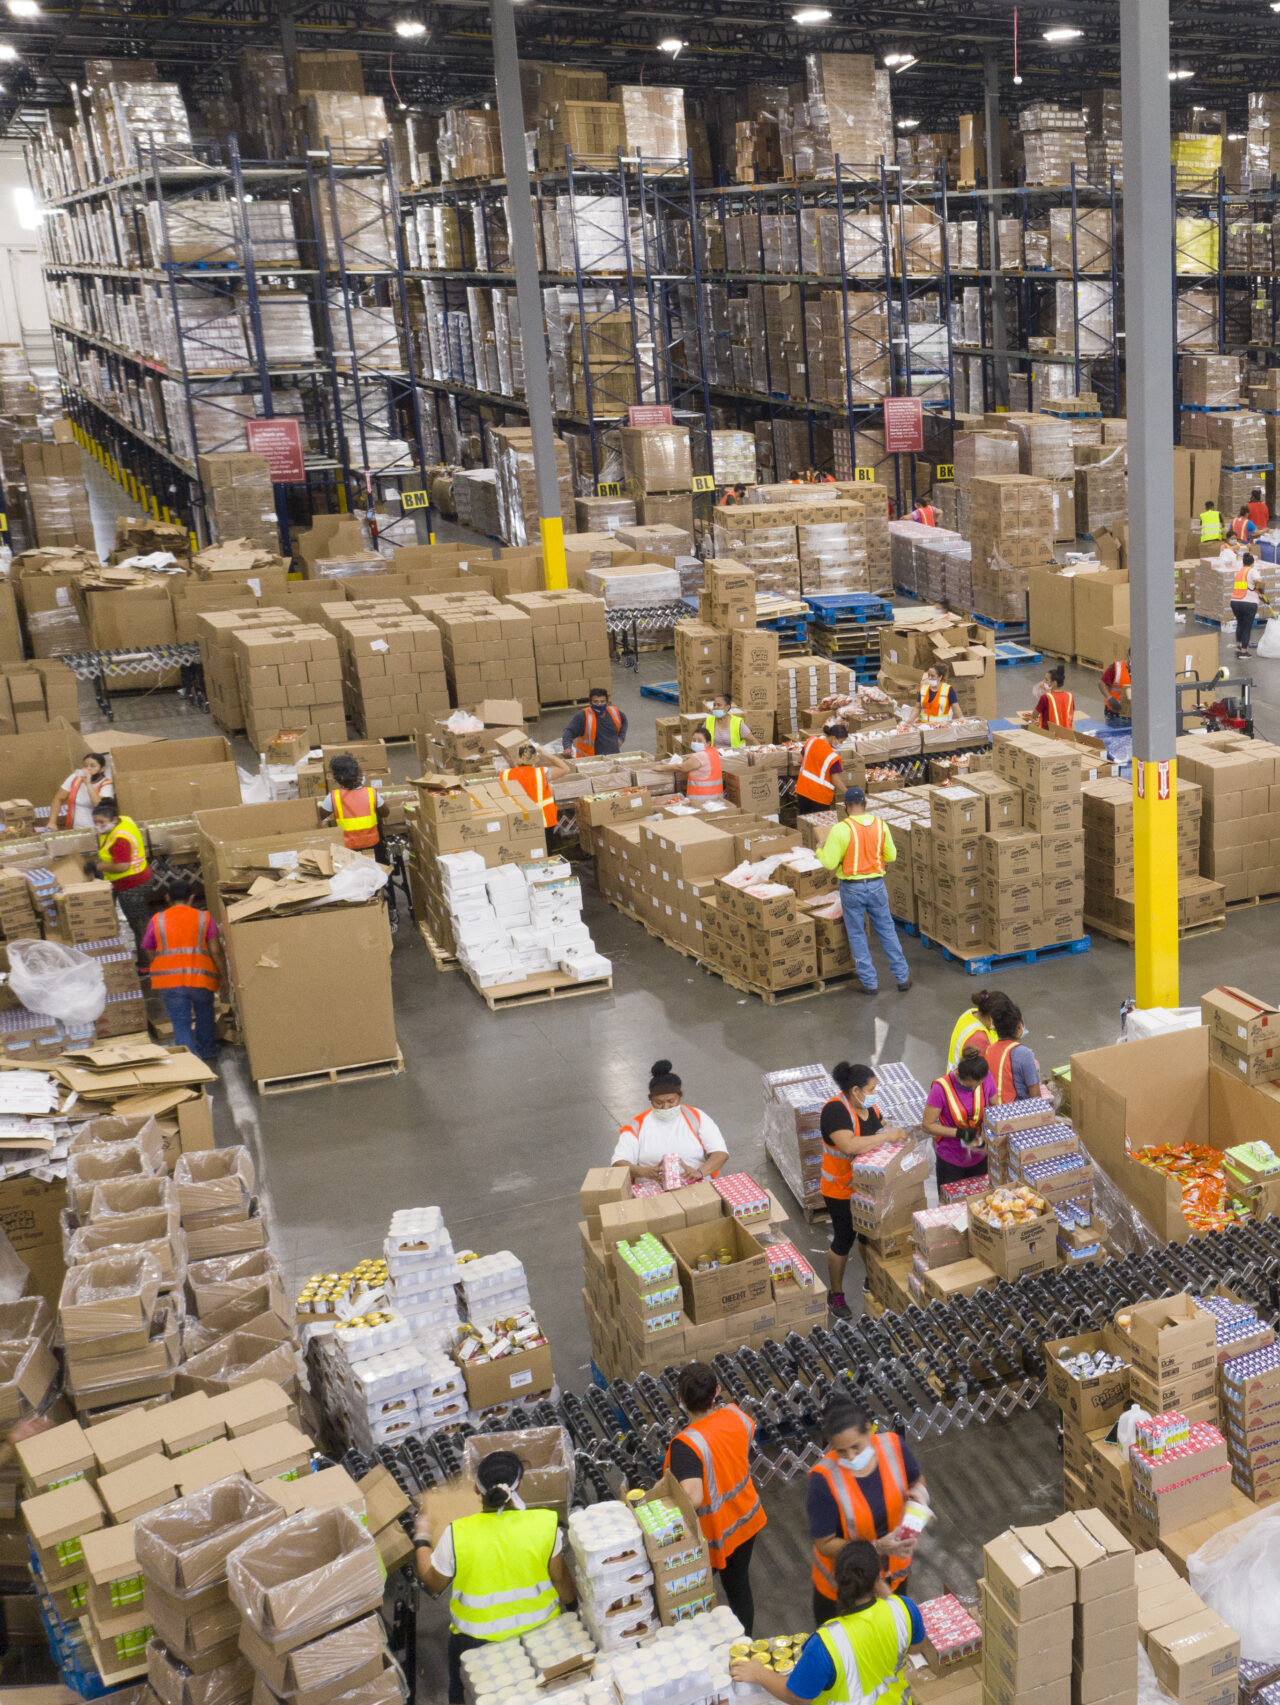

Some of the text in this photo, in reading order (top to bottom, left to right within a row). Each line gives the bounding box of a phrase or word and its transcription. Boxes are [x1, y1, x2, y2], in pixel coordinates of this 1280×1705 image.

[858, 469, 870, 480] BL
[940, 466, 954, 477] BK
[696, 478, 710, 490] BL
[600, 484, 618, 496] BM
[404, 493, 426, 507] BM
[1162, 1358, 1176, 1368] Dole
[1163, 1390, 1176, 1400] Dole
